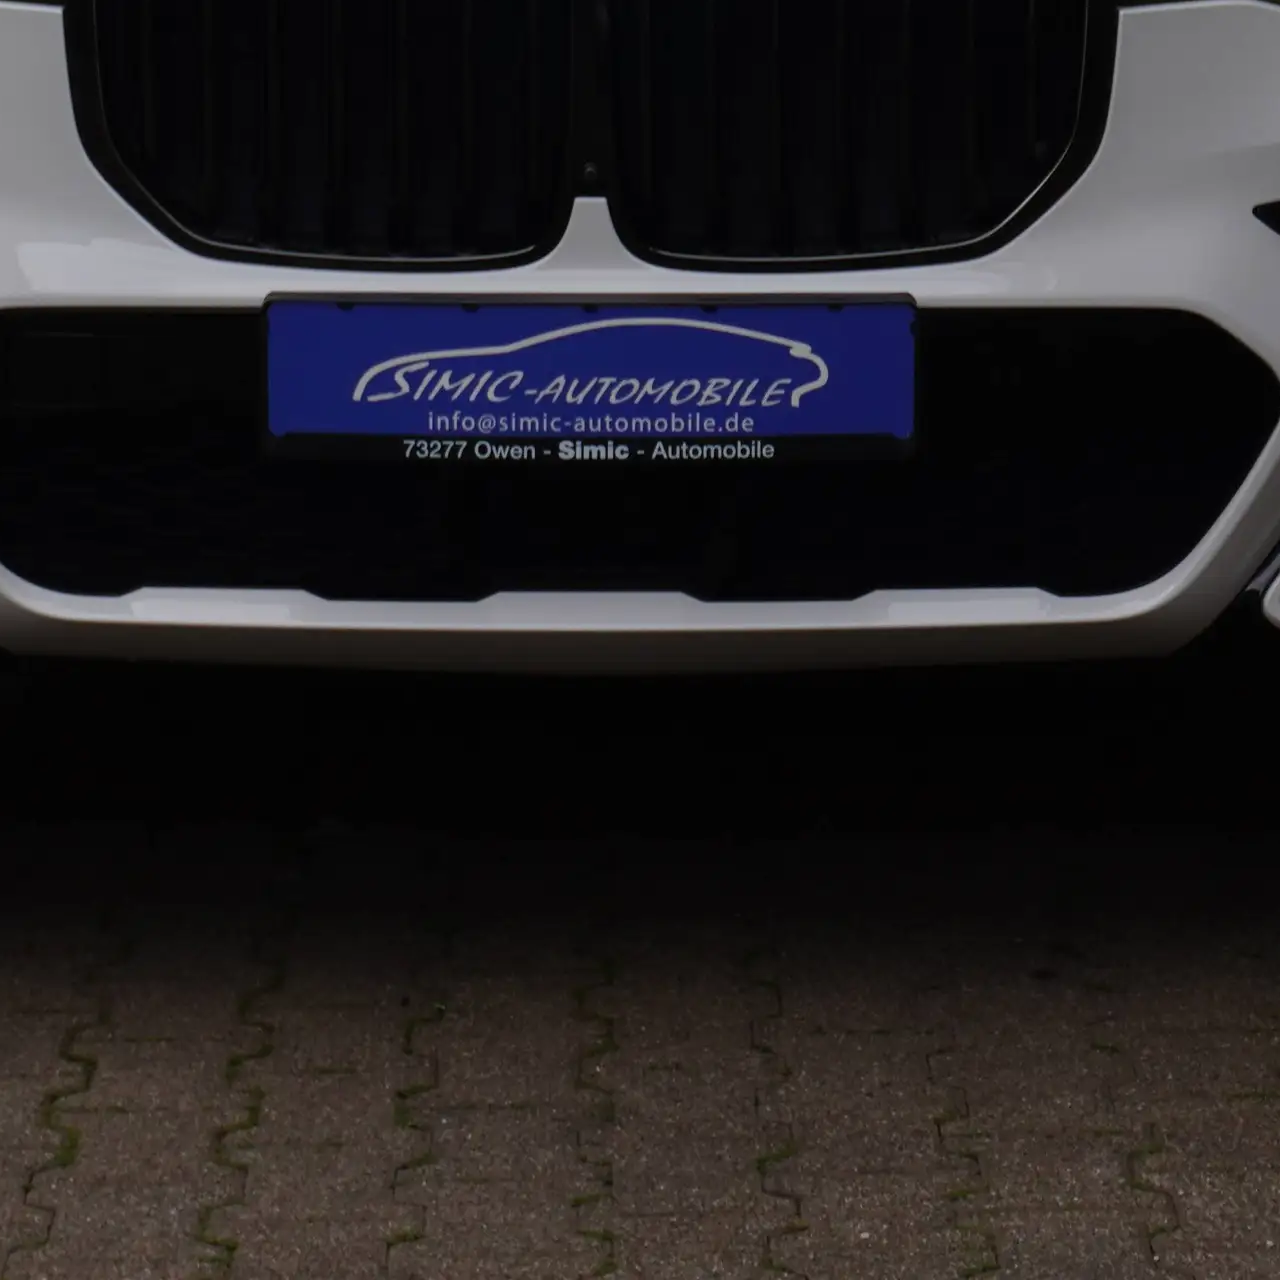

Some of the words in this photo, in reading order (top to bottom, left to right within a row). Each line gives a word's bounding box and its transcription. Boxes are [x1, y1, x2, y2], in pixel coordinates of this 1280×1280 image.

[366, 360, 793, 408] SIMIC-AUTOMOBILE
[427, 410, 755, 434] info@simic-automobile.de
[403, 439, 468, 459] 73277
[474, 440, 536, 460] Owen
[558, 440, 630, 461] Simic
[651, 440, 775, 460] Automobile
